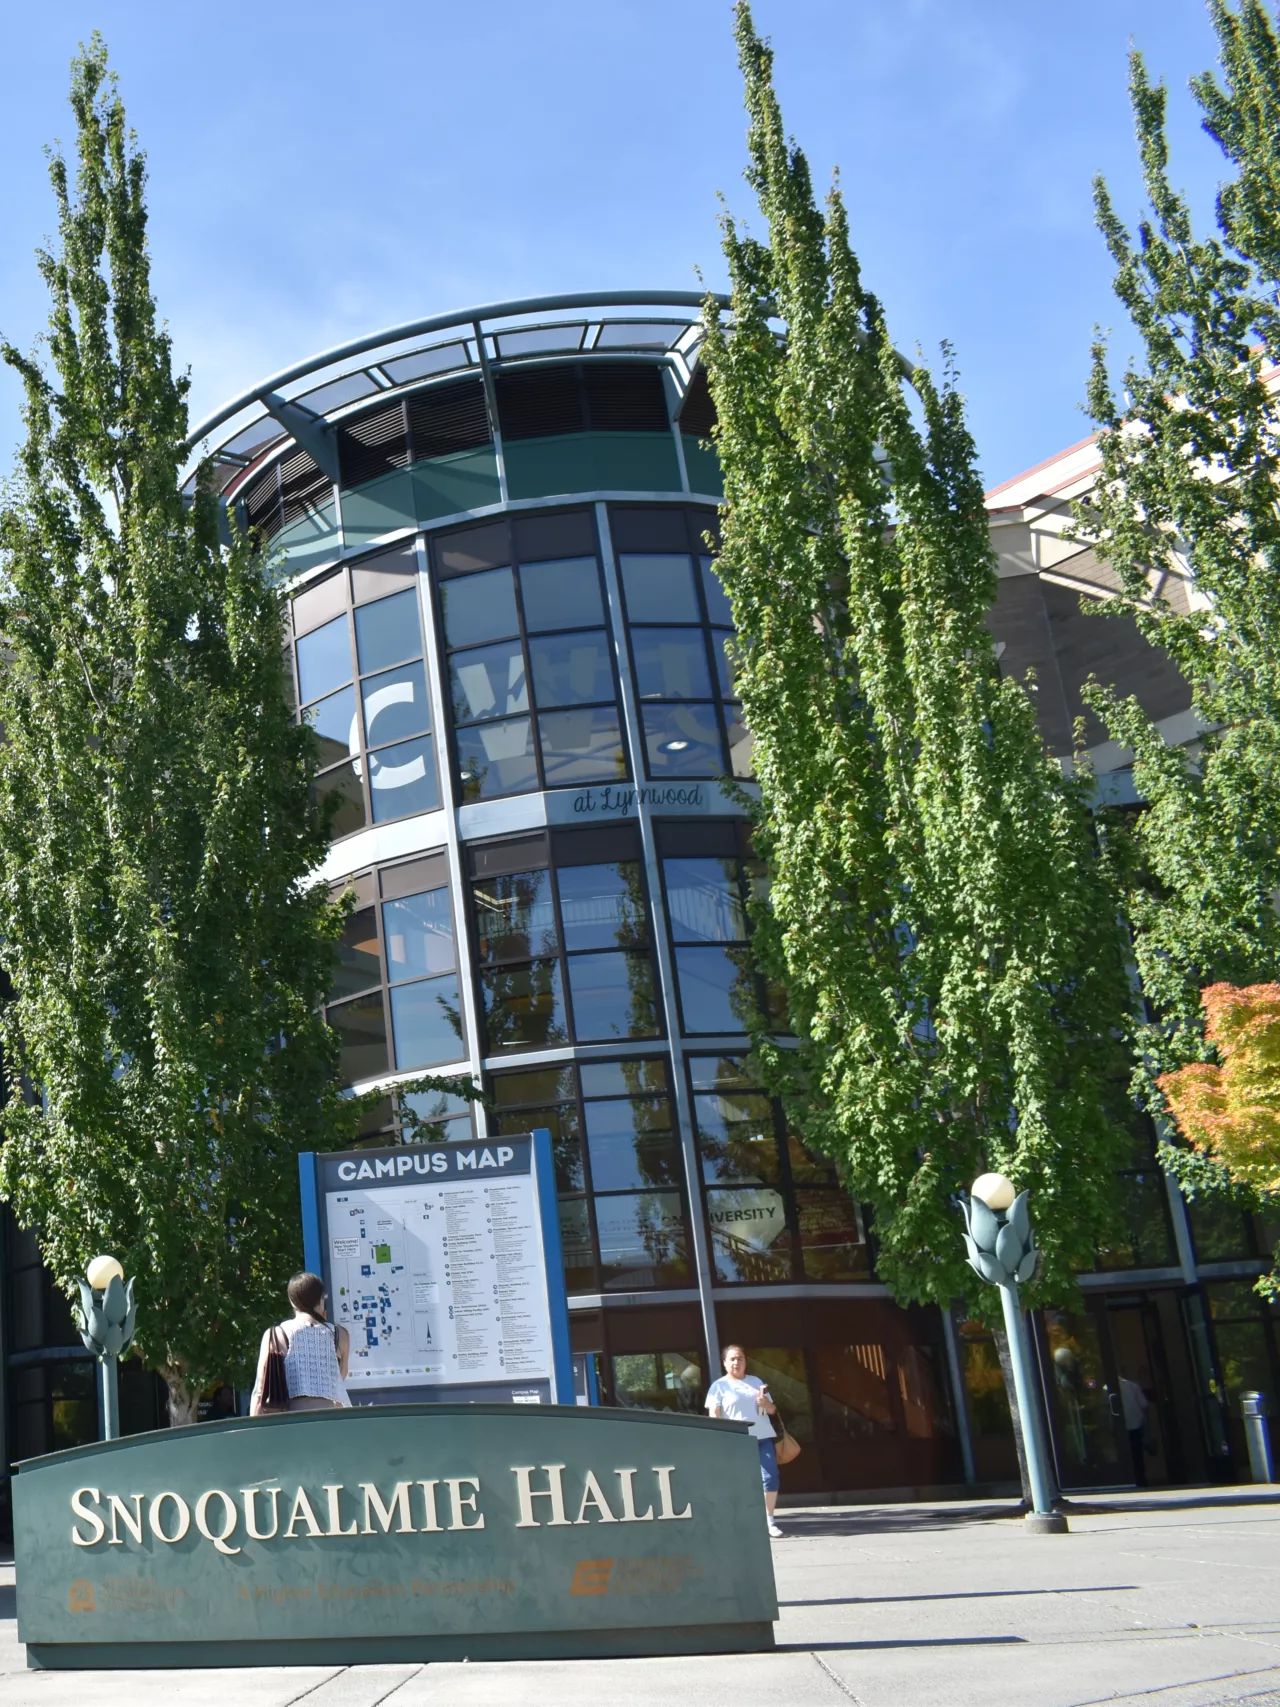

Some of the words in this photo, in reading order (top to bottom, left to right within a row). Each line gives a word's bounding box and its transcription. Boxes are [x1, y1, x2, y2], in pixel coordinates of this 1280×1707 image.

[573, 790, 596, 813] at
[600, 784, 704, 816] Lynnwood
[337, 1152, 448, 1182] CAMPUS
[455, 1146, 514, 1171] MAP
[709, 1207, 776, 1224] IVERSITY
[70, 1477, 486, 1555] SNOQUALMIE
[510, 1463, 693, 1529] HALL
